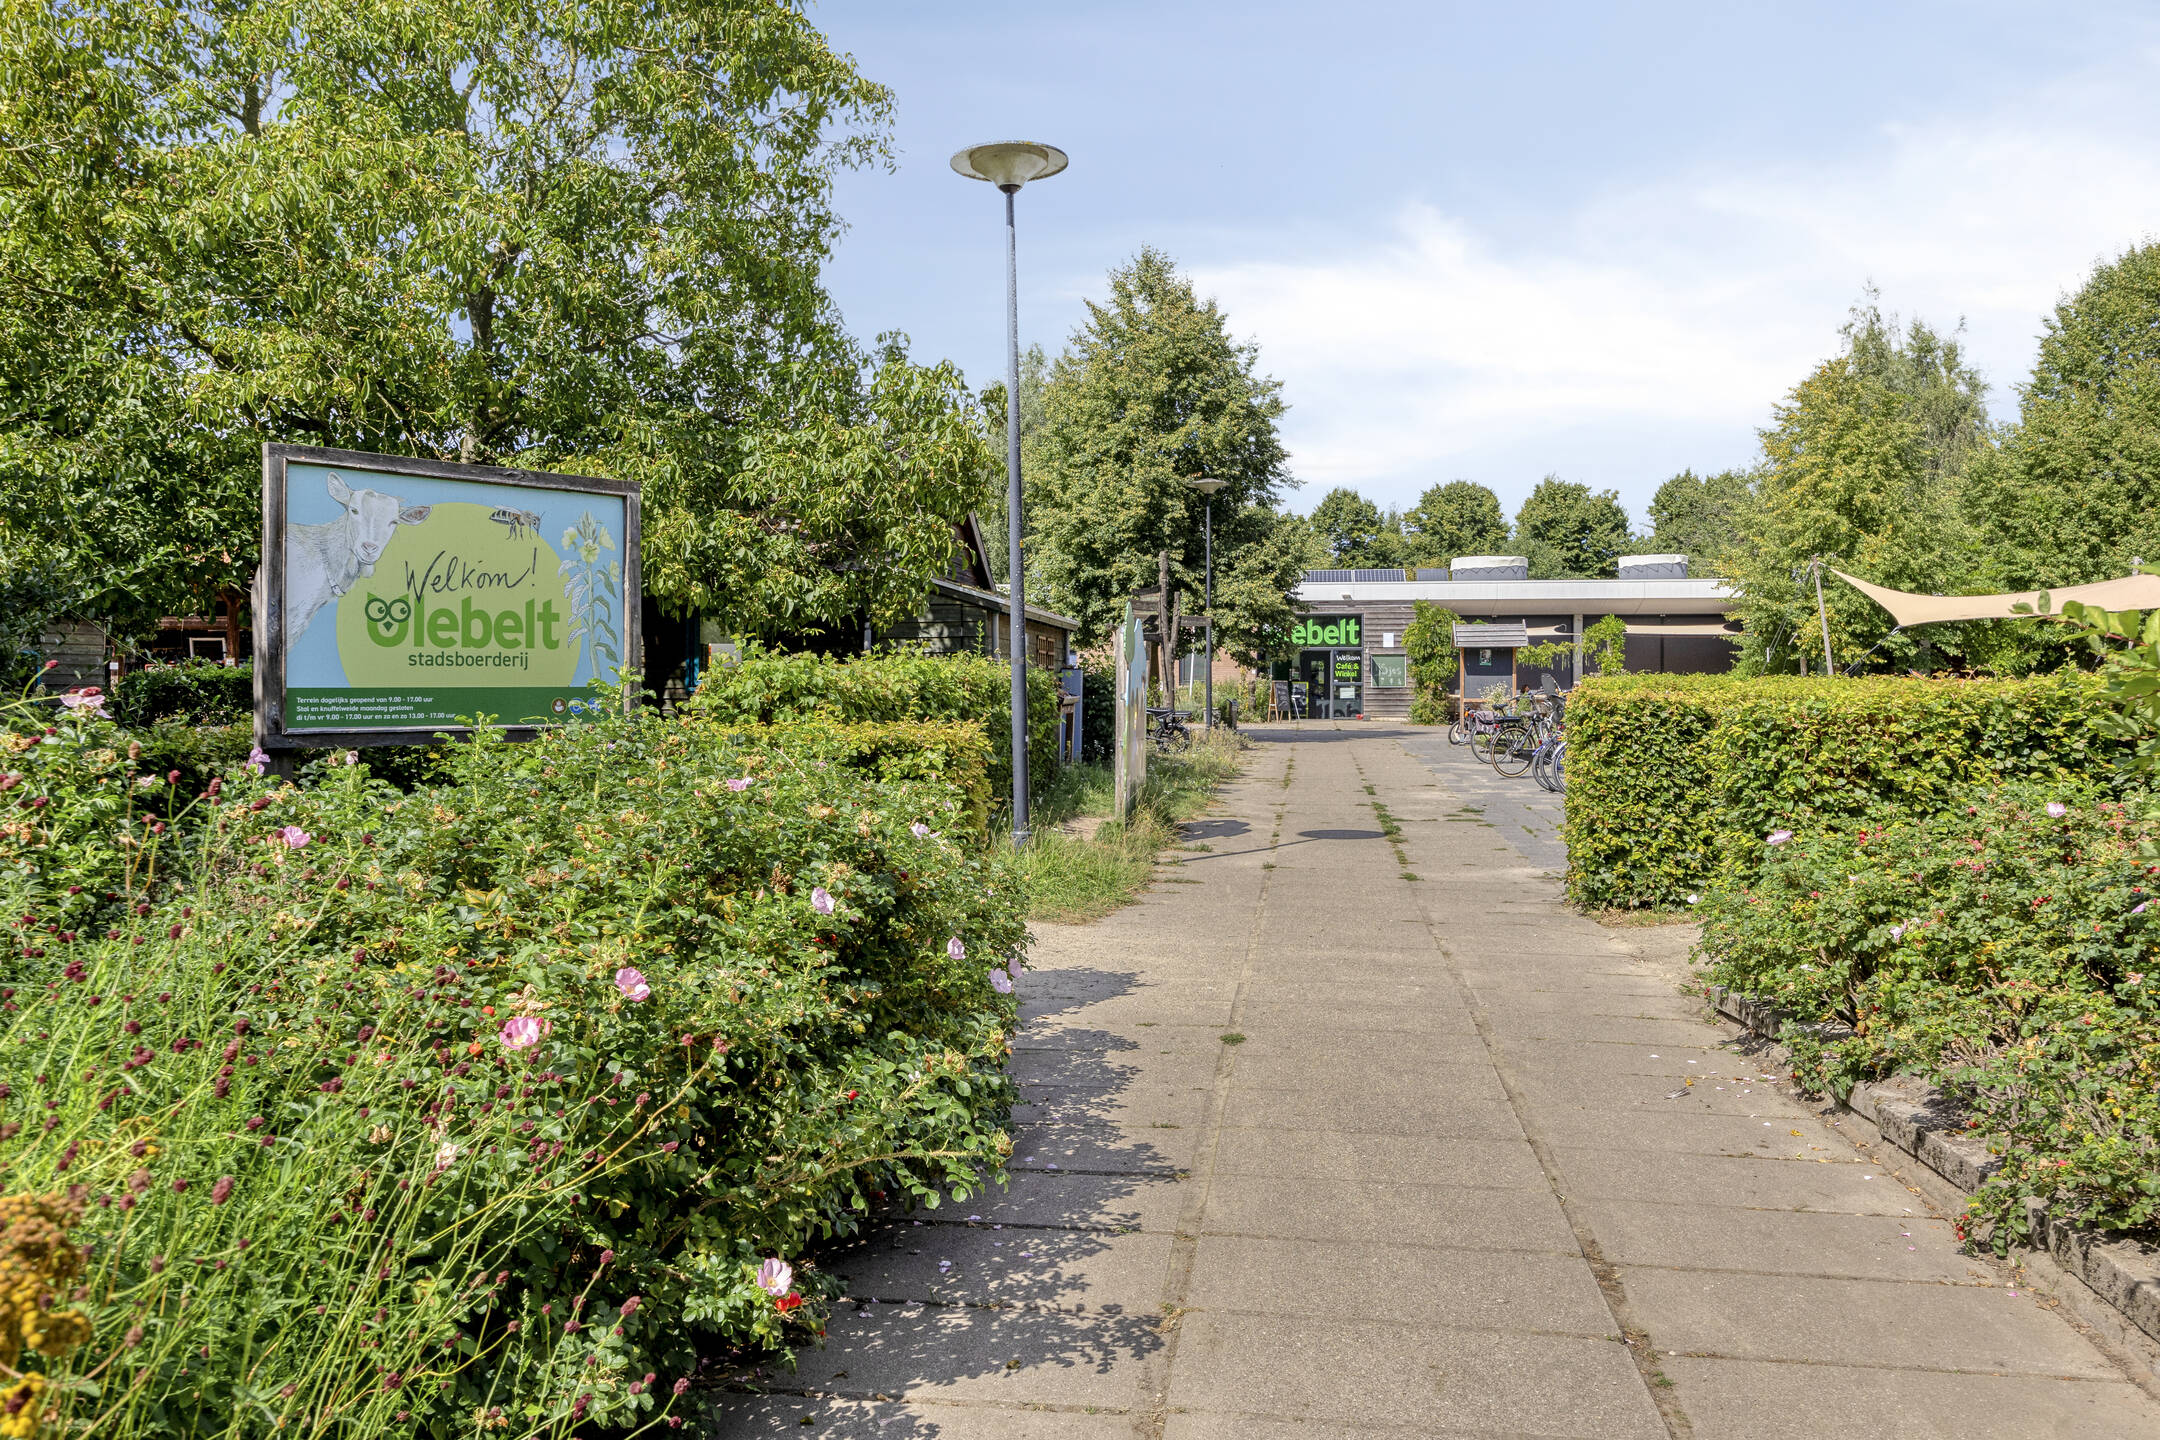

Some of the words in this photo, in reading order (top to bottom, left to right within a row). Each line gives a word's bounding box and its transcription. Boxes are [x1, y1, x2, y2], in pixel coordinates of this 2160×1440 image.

[364, 591, 561, 651] Ulebelt
[1284, 618, 1360, 645] ebelt
[408, 651, 529, 671] stadsboerderij
